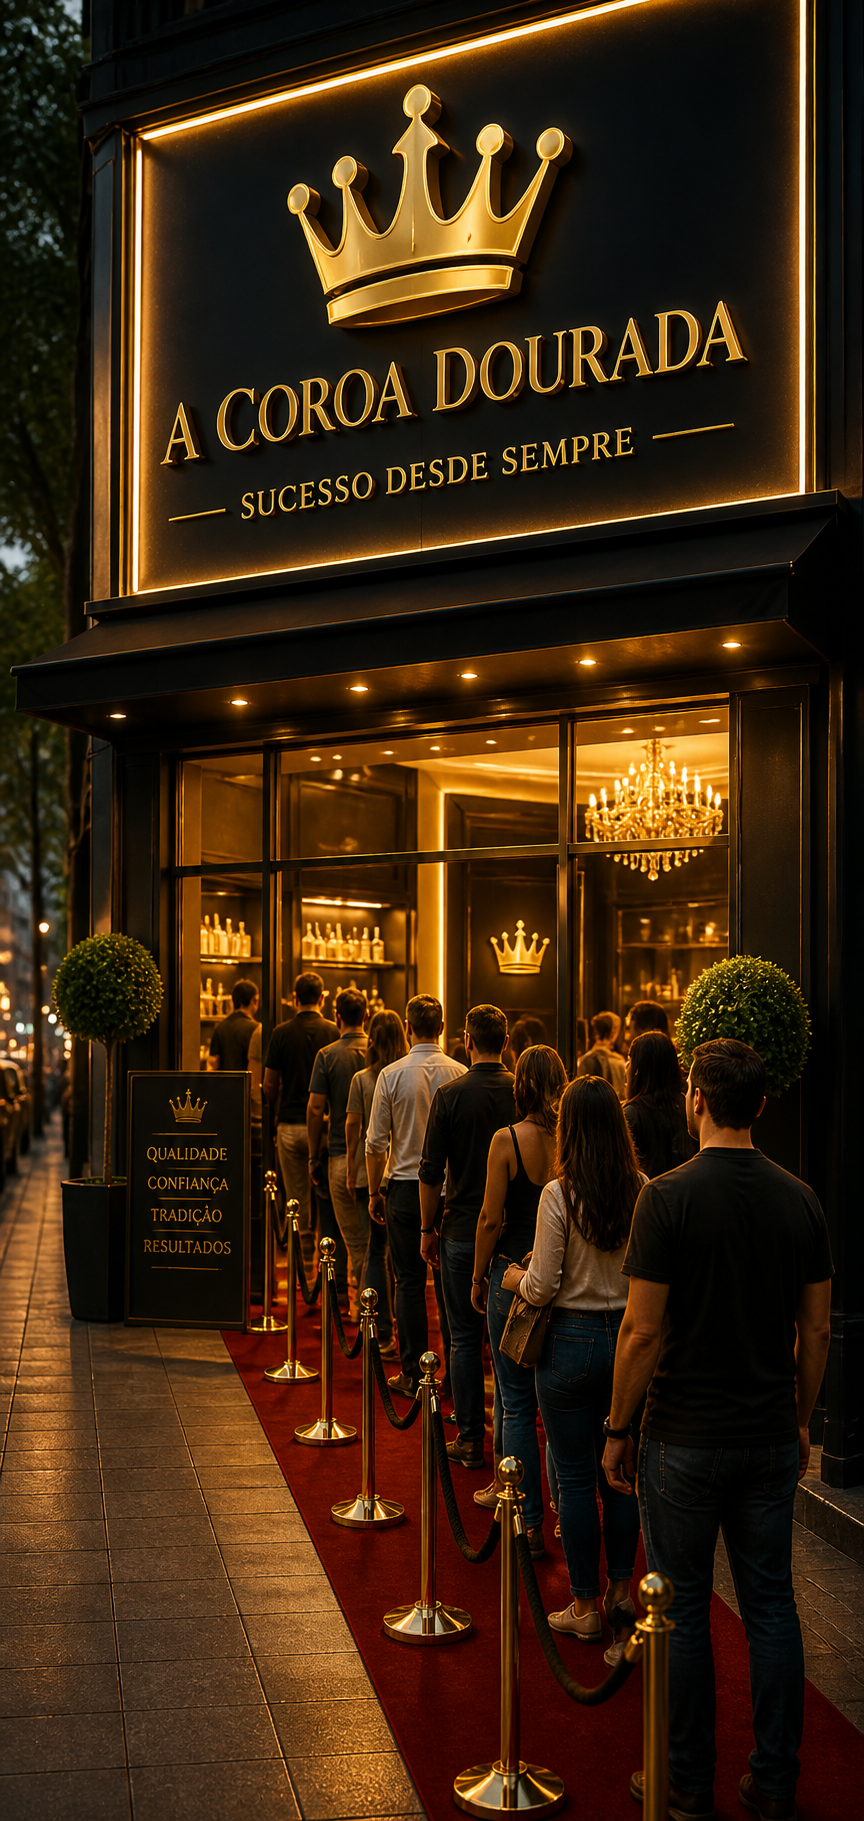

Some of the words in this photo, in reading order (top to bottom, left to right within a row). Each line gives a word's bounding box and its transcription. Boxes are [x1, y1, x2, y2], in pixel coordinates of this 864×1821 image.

[159, 401, 202, 465] A
[215, 360, 417, 453] COROA
[432, 300, 748, 412] DOURADA
[240, 471, 375, 520] SUCESSO
[385, 451, 490, 495] DESDE
[501, 427, 635, 476] SEMPRE
[146, 1147, 228, 1163] QUALIDADE
[147, 1176, 229, 1194] CONFIANÇA
[143, 1239, 231, 1255] RESULTADOS
